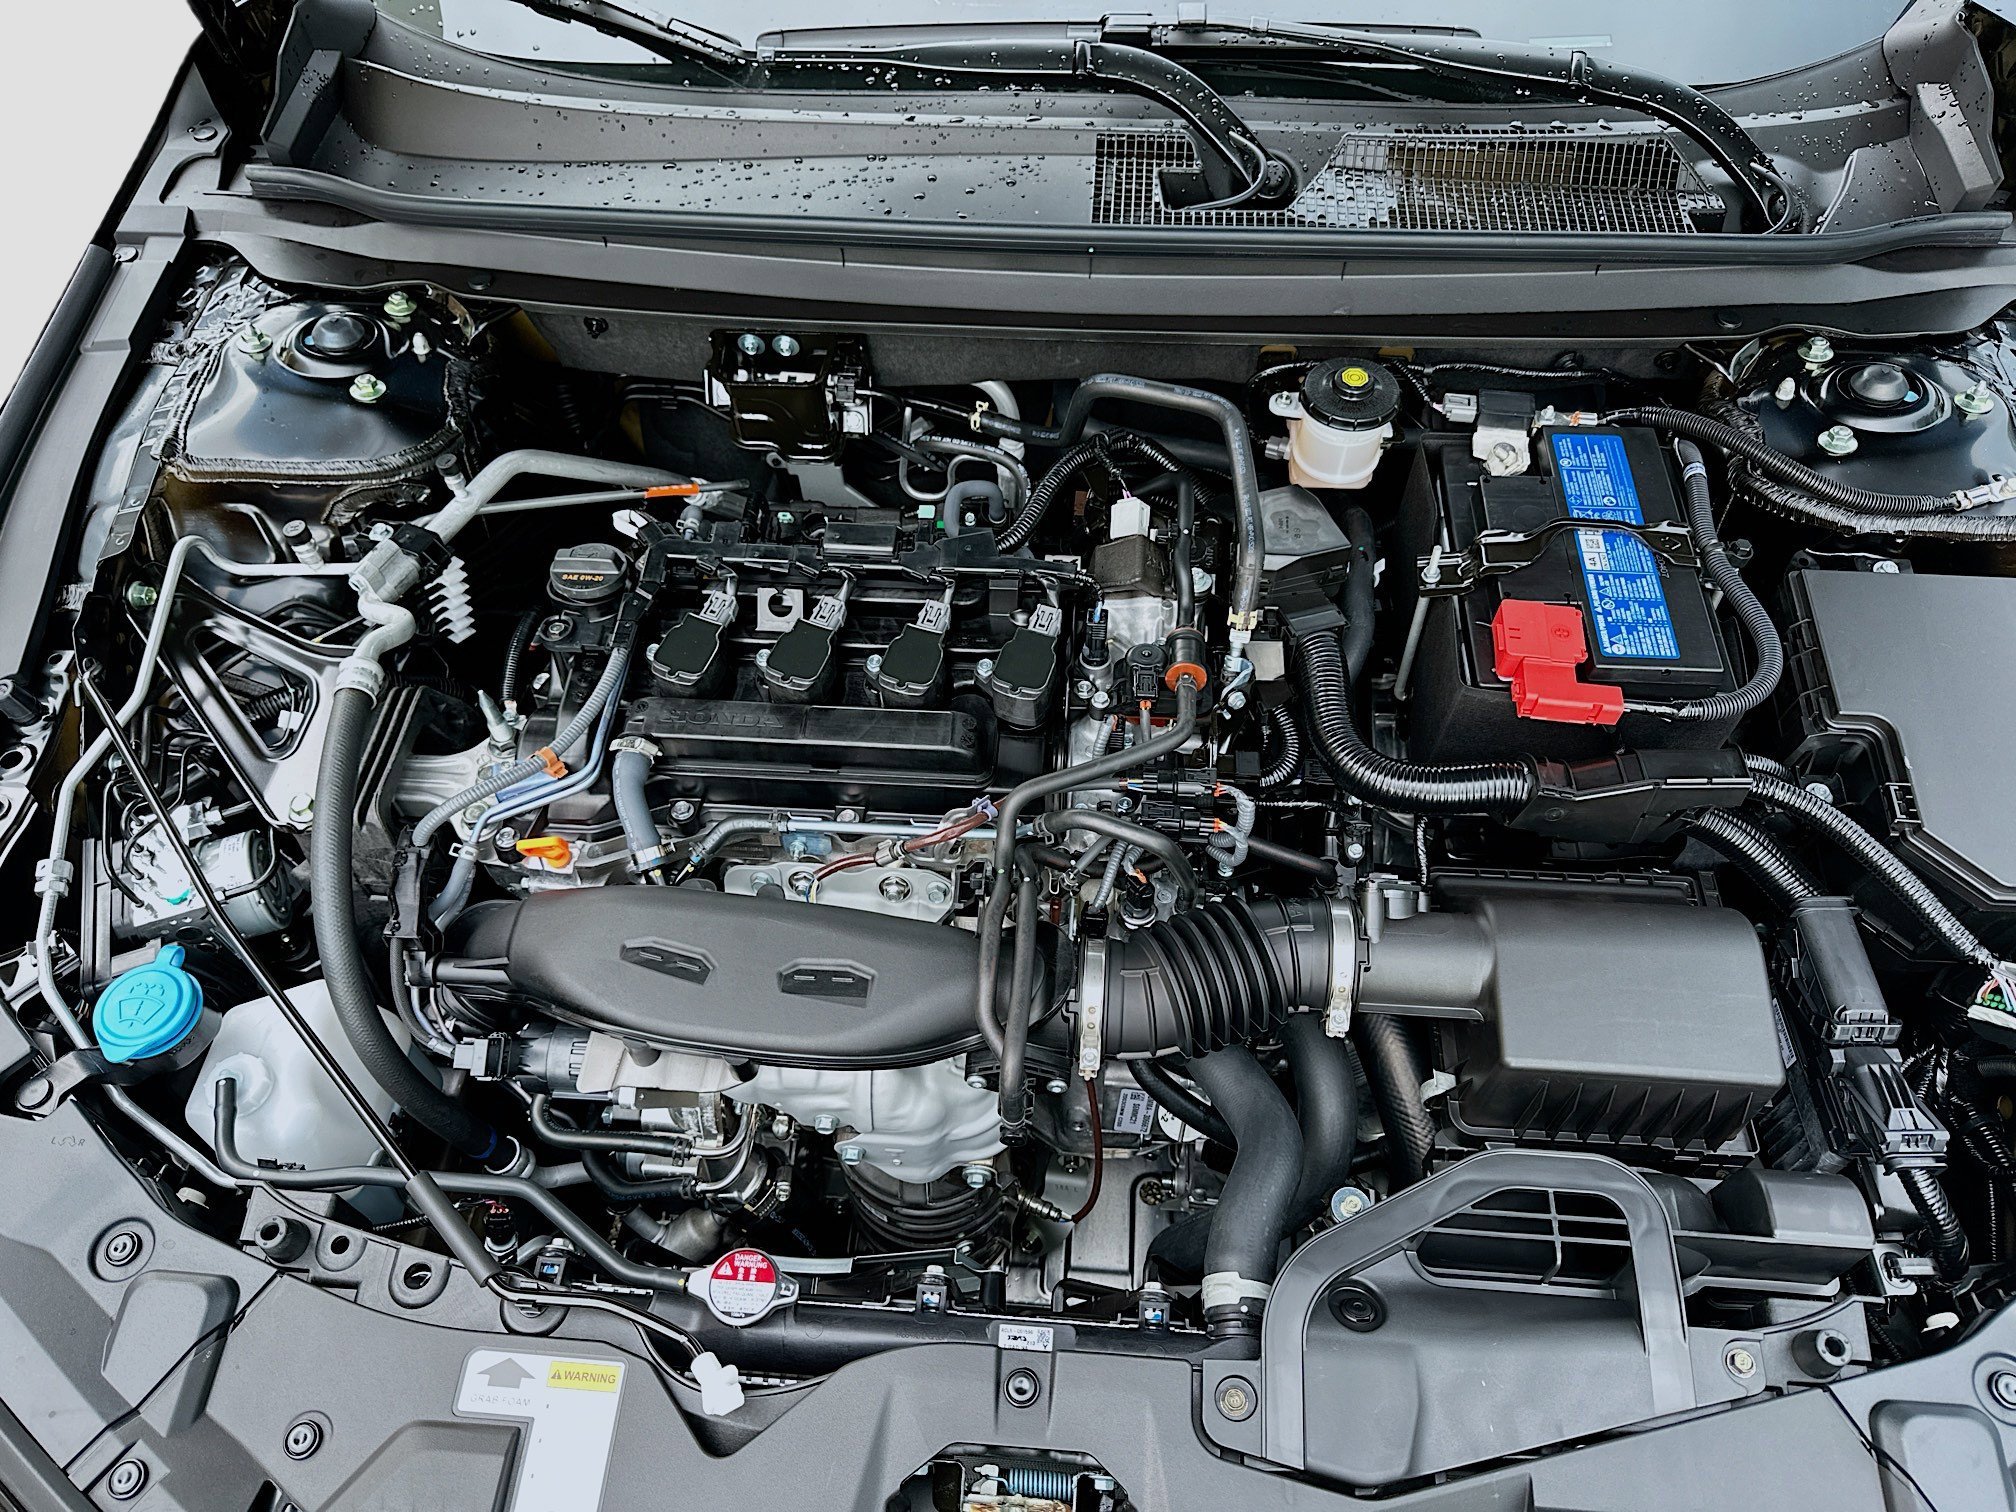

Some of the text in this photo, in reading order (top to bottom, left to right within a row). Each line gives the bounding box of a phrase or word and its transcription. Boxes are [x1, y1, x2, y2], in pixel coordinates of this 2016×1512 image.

[1589, 556, 1597, 567] 4A
[561, 573, 604, 582] SAE 0W-20
[660, 709, 784, 728] HONDA
[734, 1253, 762, 1262] DANGER
[564, 1370, 616, 1384] WARNING
